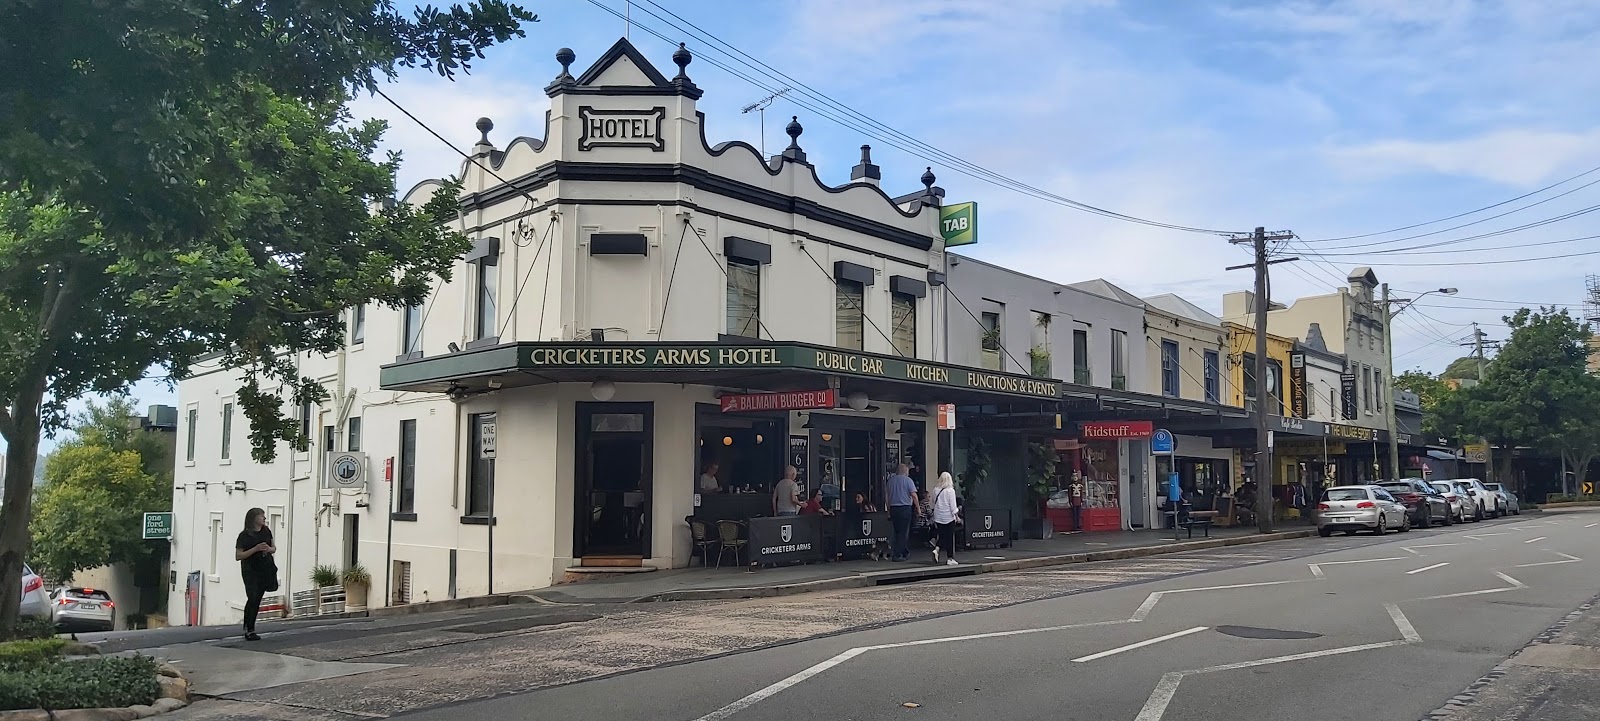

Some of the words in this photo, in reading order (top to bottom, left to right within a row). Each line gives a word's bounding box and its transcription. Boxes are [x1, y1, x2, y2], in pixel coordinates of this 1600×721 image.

[590, 119, 654, 138] HOTEL
[943, 217, 968, 232] TAB
[530, 348, 647, 365] CRICKETERS
[653, 348, 710, 365] ARMS
[718, 348, 781, 364] HOTEL
[816, 351, 857, 372] PUBLIC
[861, 357, 884, 375] BAR
[906, 363, 949, 383] KITCHEN
[967, 372, 1018, 392] FUNCTIONS
[1020, 379, 1027, 392] &
[1027, 380, 1056, 396] EVENTS
[741, 396, 778, 410] BALMAIN
[781, 393, 815, 408] BURGER
[817, 392, 826, 403] CO
[484, 425, 494, 434] ONE
[1084, 425, 1129, 437] Kidstuff
[1331, 424, 1340, 436] THE
[1340, 425, 1358, 438] VILLAGE
[1358, 428, 1371, 440] SPORT
[483, 437, 495, 445] WAY
[795, 453, 802, 466] 6
[761, 543, 796, 555] CRICKETERS
[796, 542, 812, 551] ARMS
[845, 538, 875, 547] CRICKETERS
